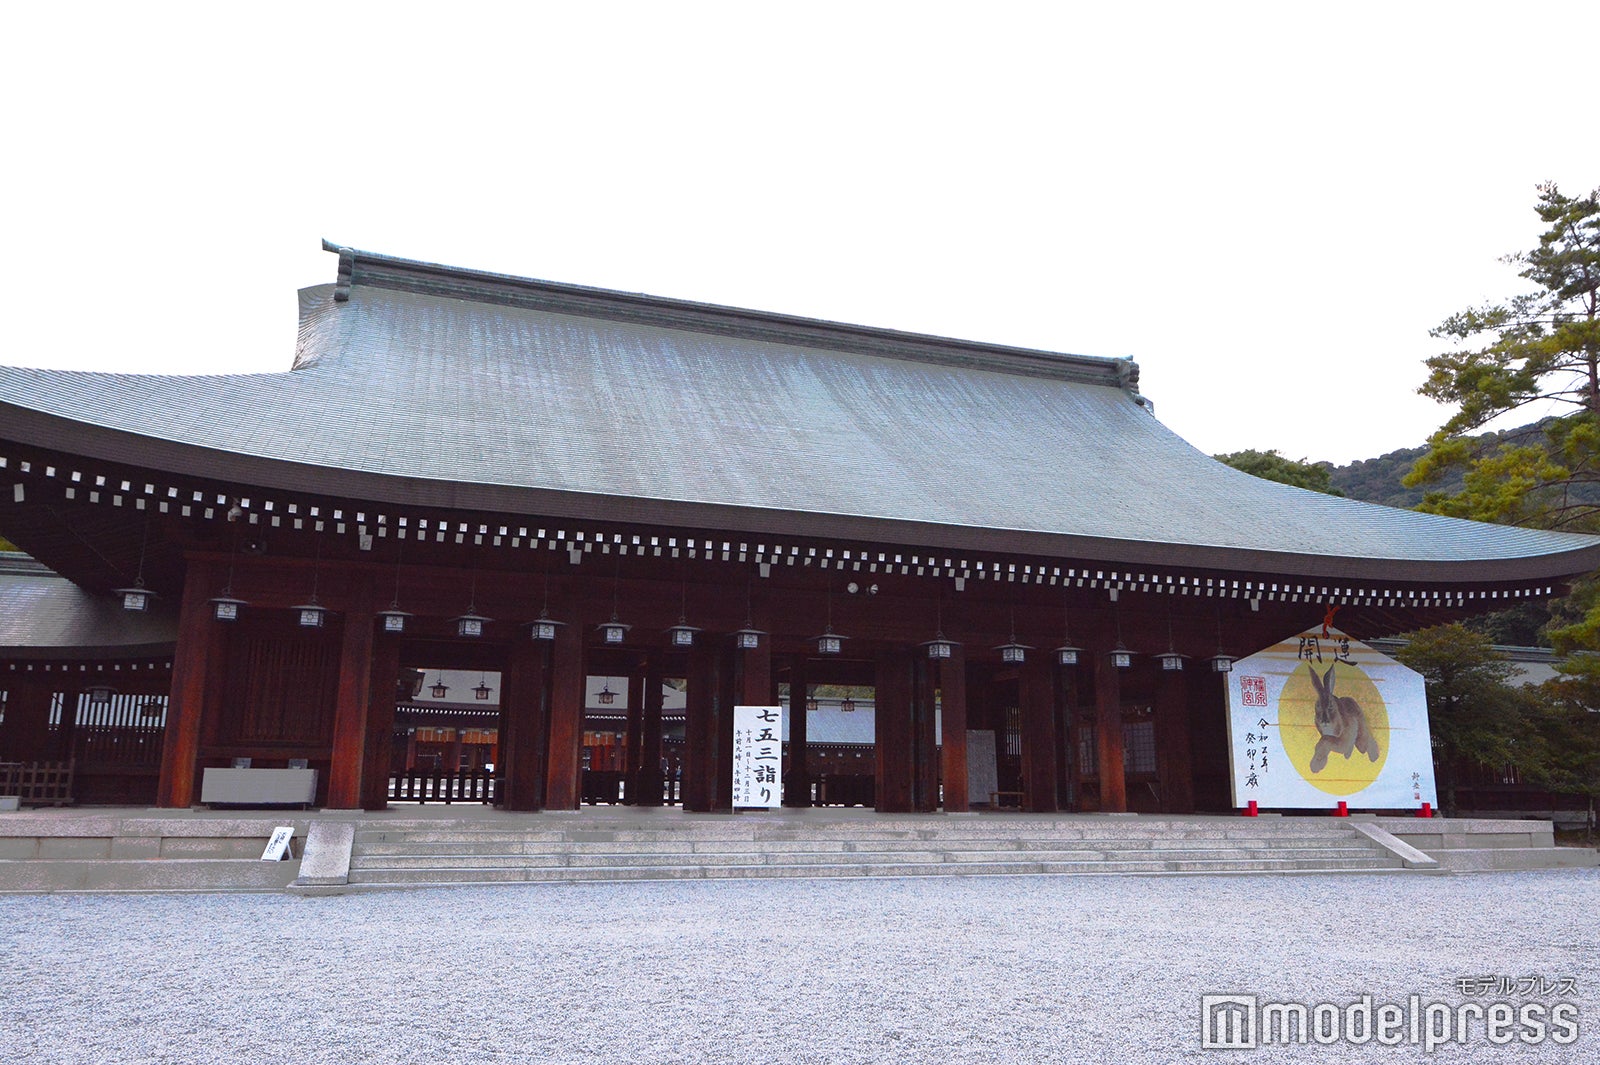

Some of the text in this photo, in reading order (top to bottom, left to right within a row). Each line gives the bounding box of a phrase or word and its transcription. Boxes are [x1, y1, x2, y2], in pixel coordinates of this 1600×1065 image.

[1298, 635, 1358, 666] 開運
[753, 709, 779, 803] 七五三詣り
[1257, 718, 1269, 773] 令和五年
